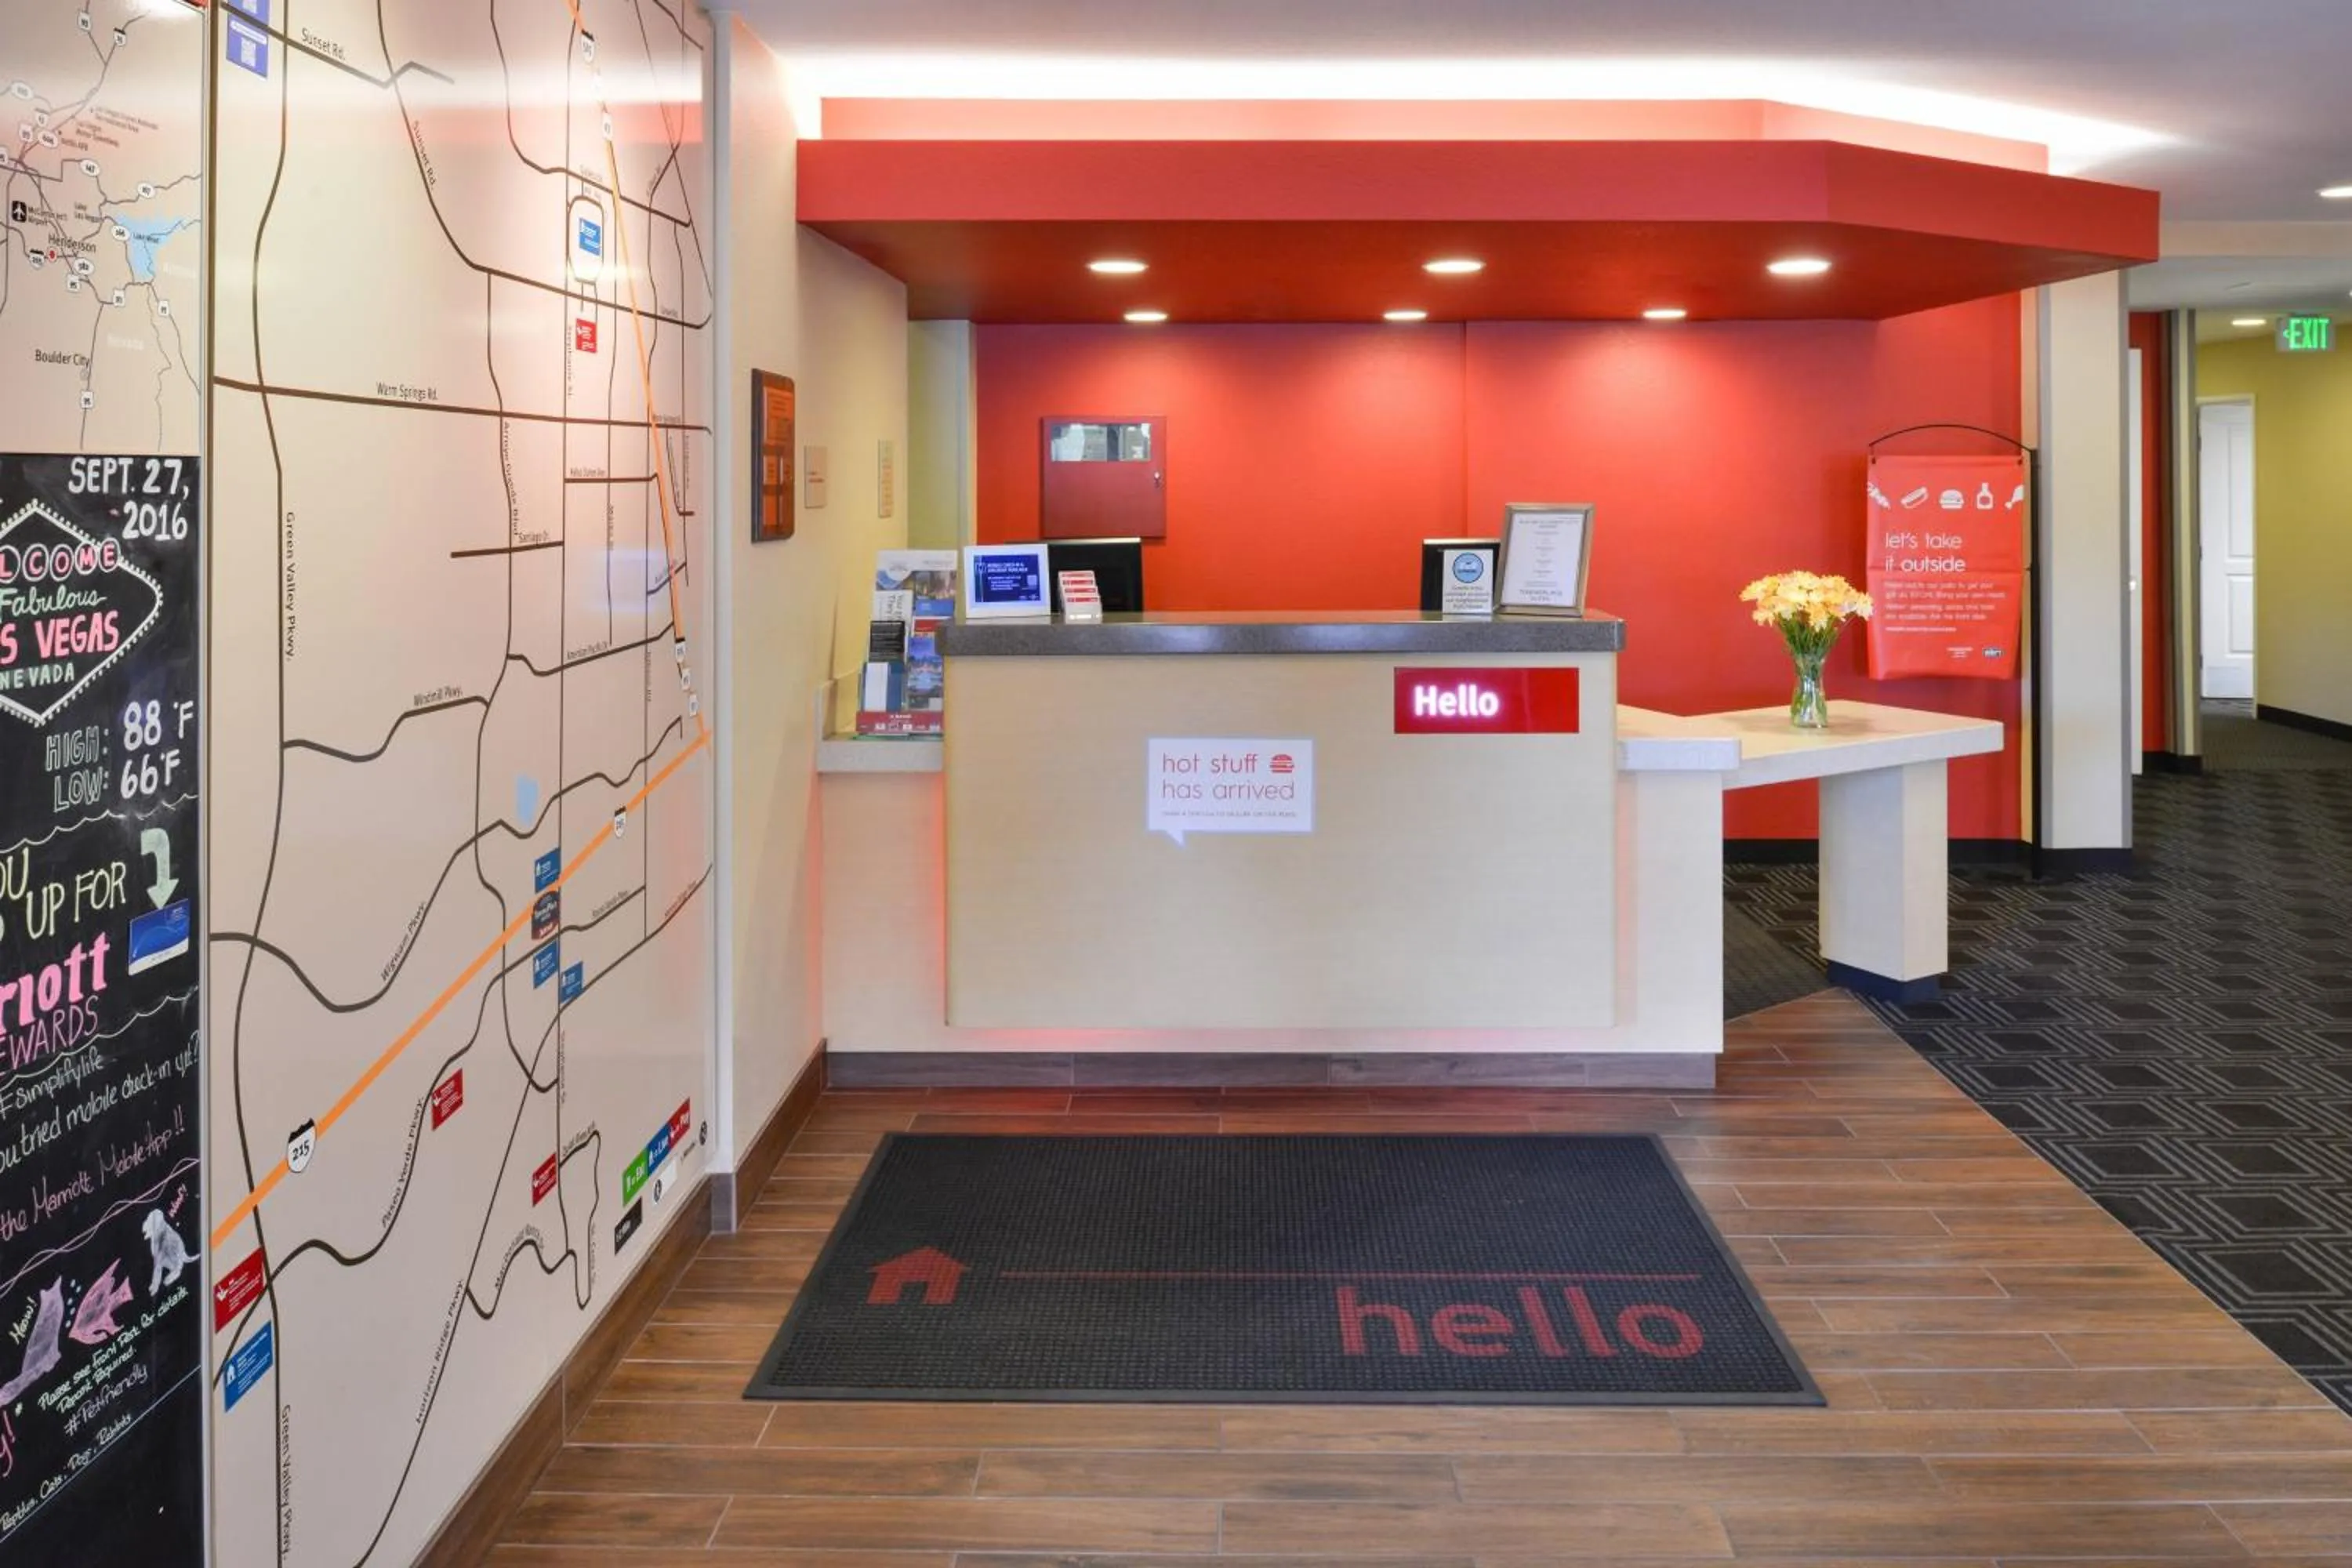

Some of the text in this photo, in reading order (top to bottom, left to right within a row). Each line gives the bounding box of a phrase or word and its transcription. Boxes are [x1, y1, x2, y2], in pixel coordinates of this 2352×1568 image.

[301, 27, 347, 60] Sunset Rd.
[48, 234, 96, 253] Henderson
[2289, 318, 2329, 350] EXIT
[35, 349, 90, 368] Boulder City
[399, 384, 426, 401] Springs
[68, 457, 189, 499] SEPT. 27,
[122, 500, 187, 540] 2016
[286, 511, 296, 559] Green
[1886, 532, 1962, 549] let's take
[1886, 556, 1965, 572] it outside
[285, 562, 296, 612] Valley
[34, 610, 119, 659] VEGAS
[0, 662, 74, 690] NEVADA
[1414, 684, 1499, 717] Hello
[45, 725, 109, 771] HIGH:
[124, 699, 162, 751] 88
[1163, 753, 1259, 774] hot stuff
[53, 766, 109, 813] LOW:
[1162, 779, 1294, 800] has arrived
[27, 862, 126, 939] UP FOR
[20, 1105, 62, 1156] tried
[67, 1083, 118, 1131] mobile
[122, 1062, 171, 1098] check-in
[292, 1140, 310, 1162] 215
[32, 1171, 94, 1224] Marriott
[98, 1142, 147, 1185] Mobile
[1338, 1286, 1704, 1359] hello
[281, 1404, 291, 1456] Green
[281, 1455, 292, 1508] Valley
